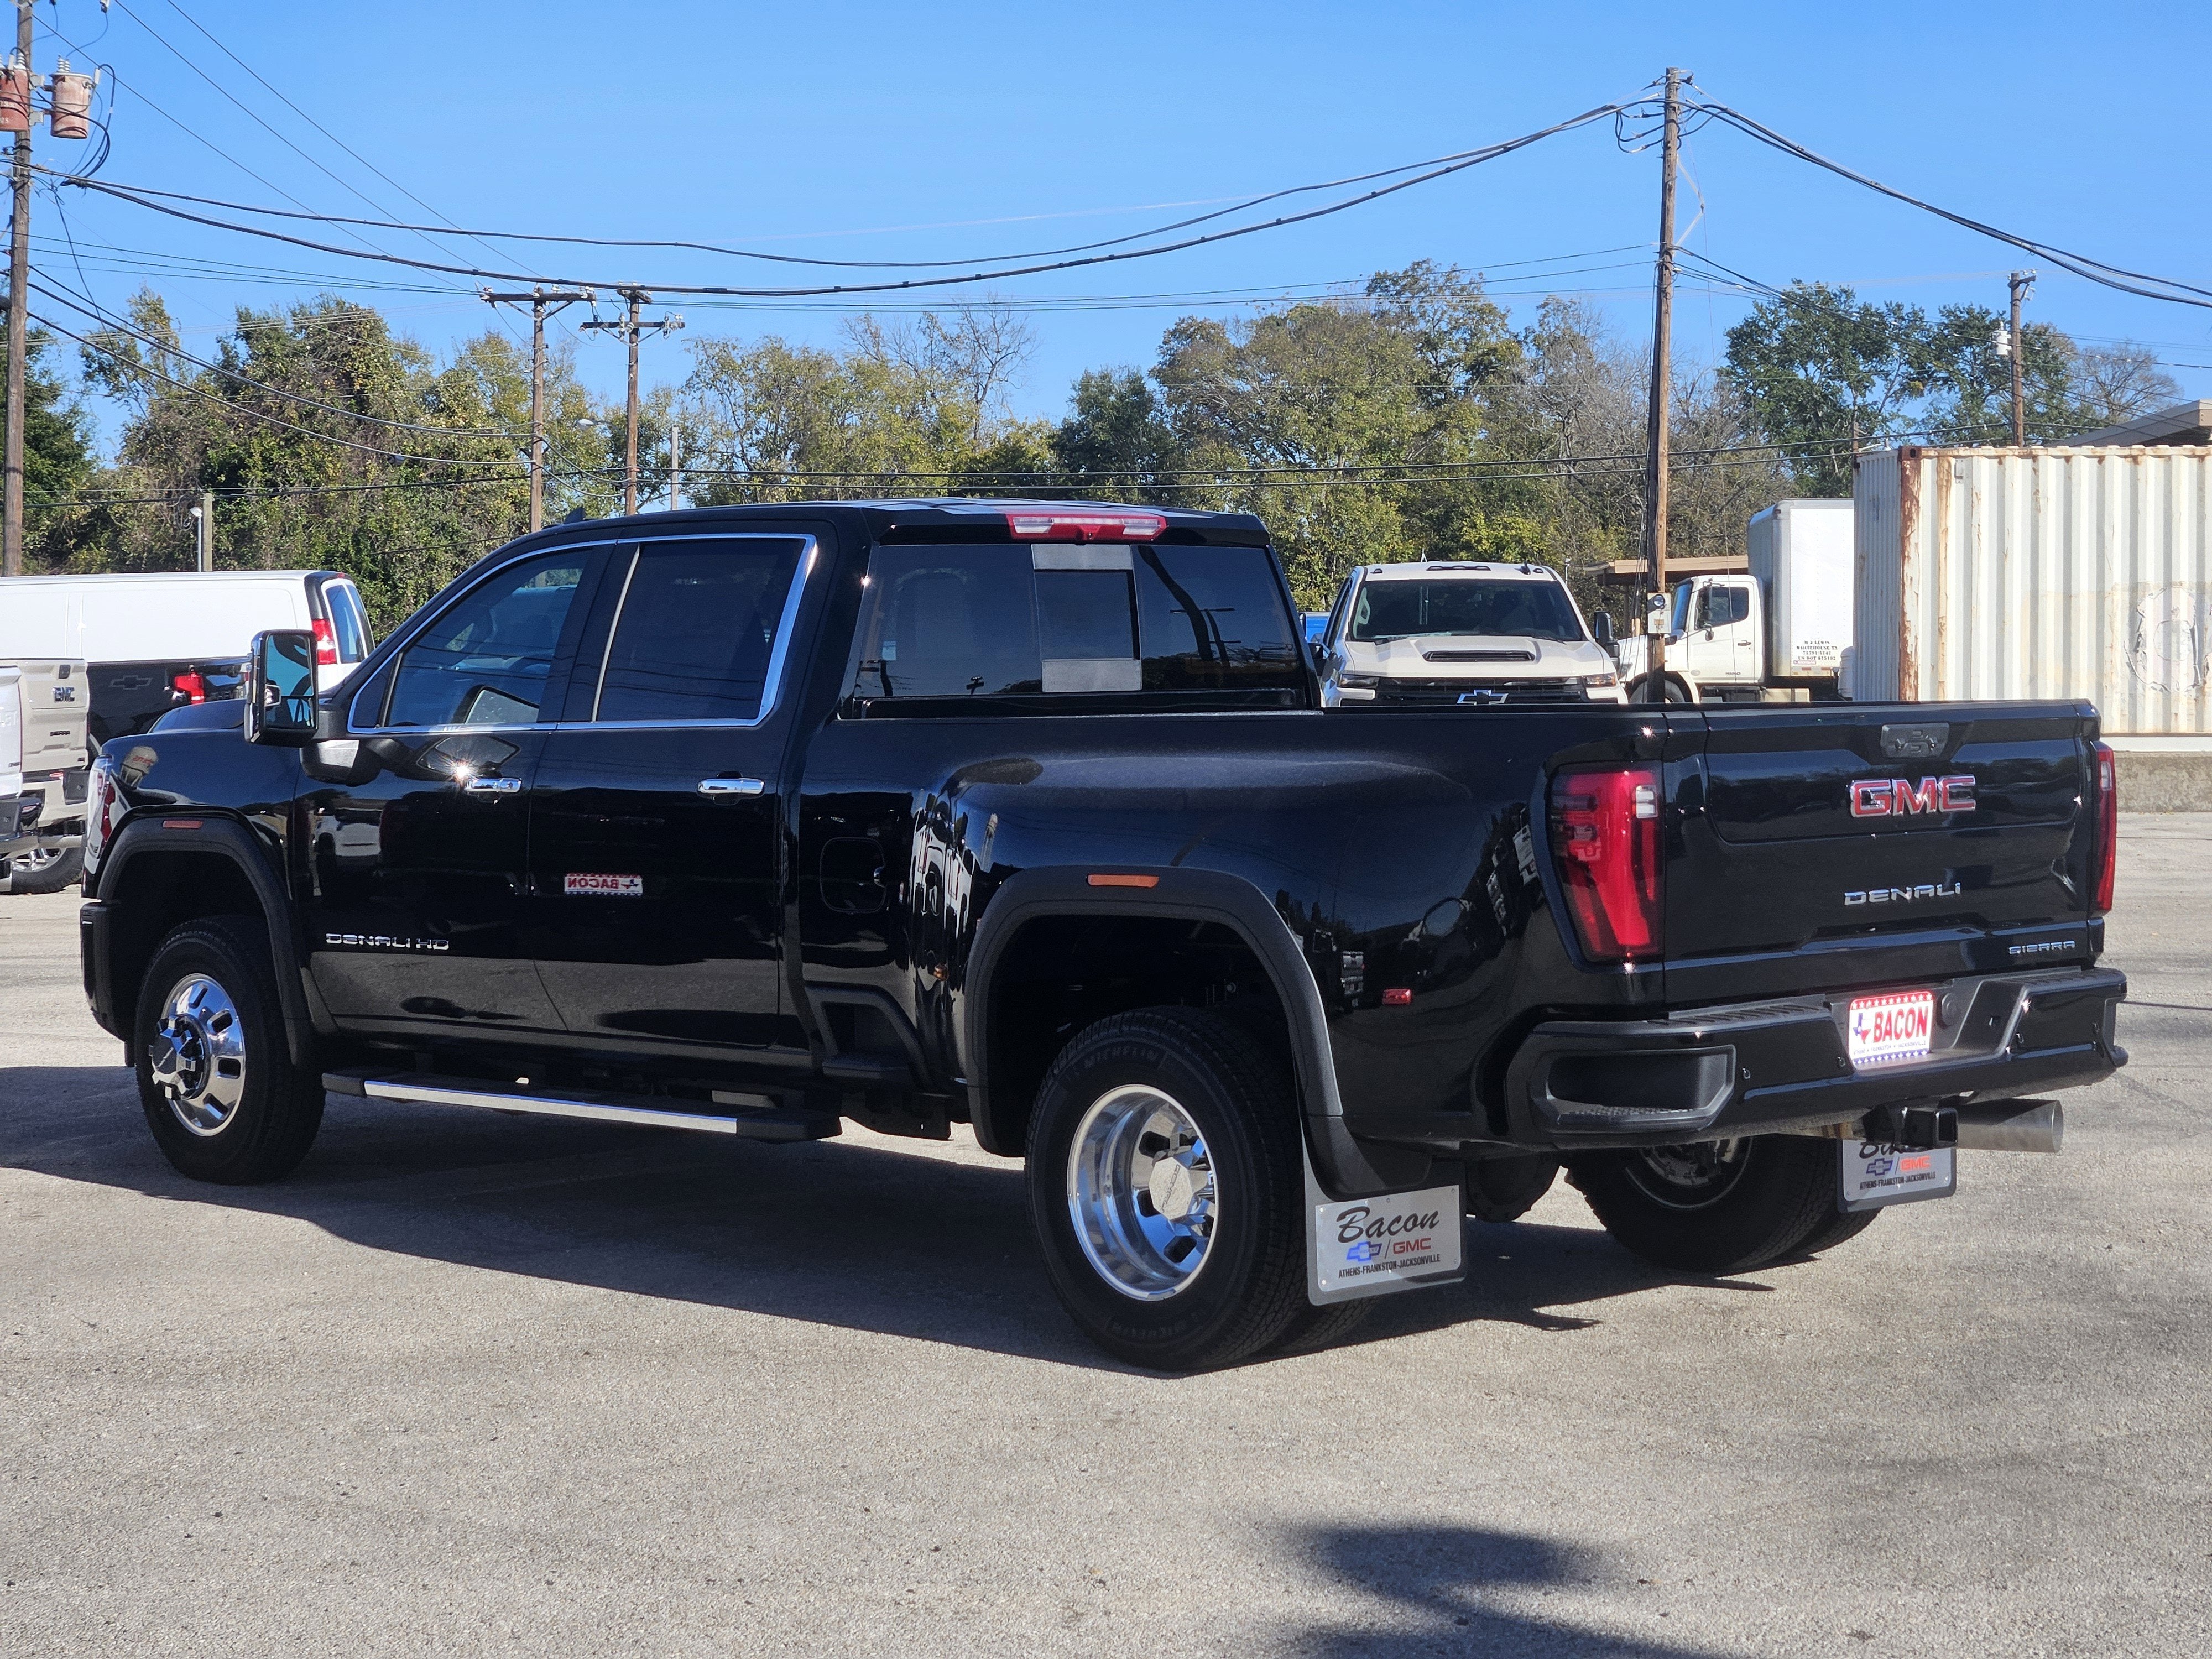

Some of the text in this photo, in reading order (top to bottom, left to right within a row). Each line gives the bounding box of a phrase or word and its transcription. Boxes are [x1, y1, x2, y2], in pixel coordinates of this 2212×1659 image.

[1850, 774, 1976, 817] GMC
[1844, 882, 1961, 905] DENALI
[326, 933, 449, 950] DENALI HD
[2008, 941, 2075, 954] SIERRA
[1873, 1006, 1929, 1043] BACON
[1901, 1155, 1930, 1171] GMC
[1336, 1206, 1440, 1243] Bacon
[1393, 1237, 1432, 1255] GMC
